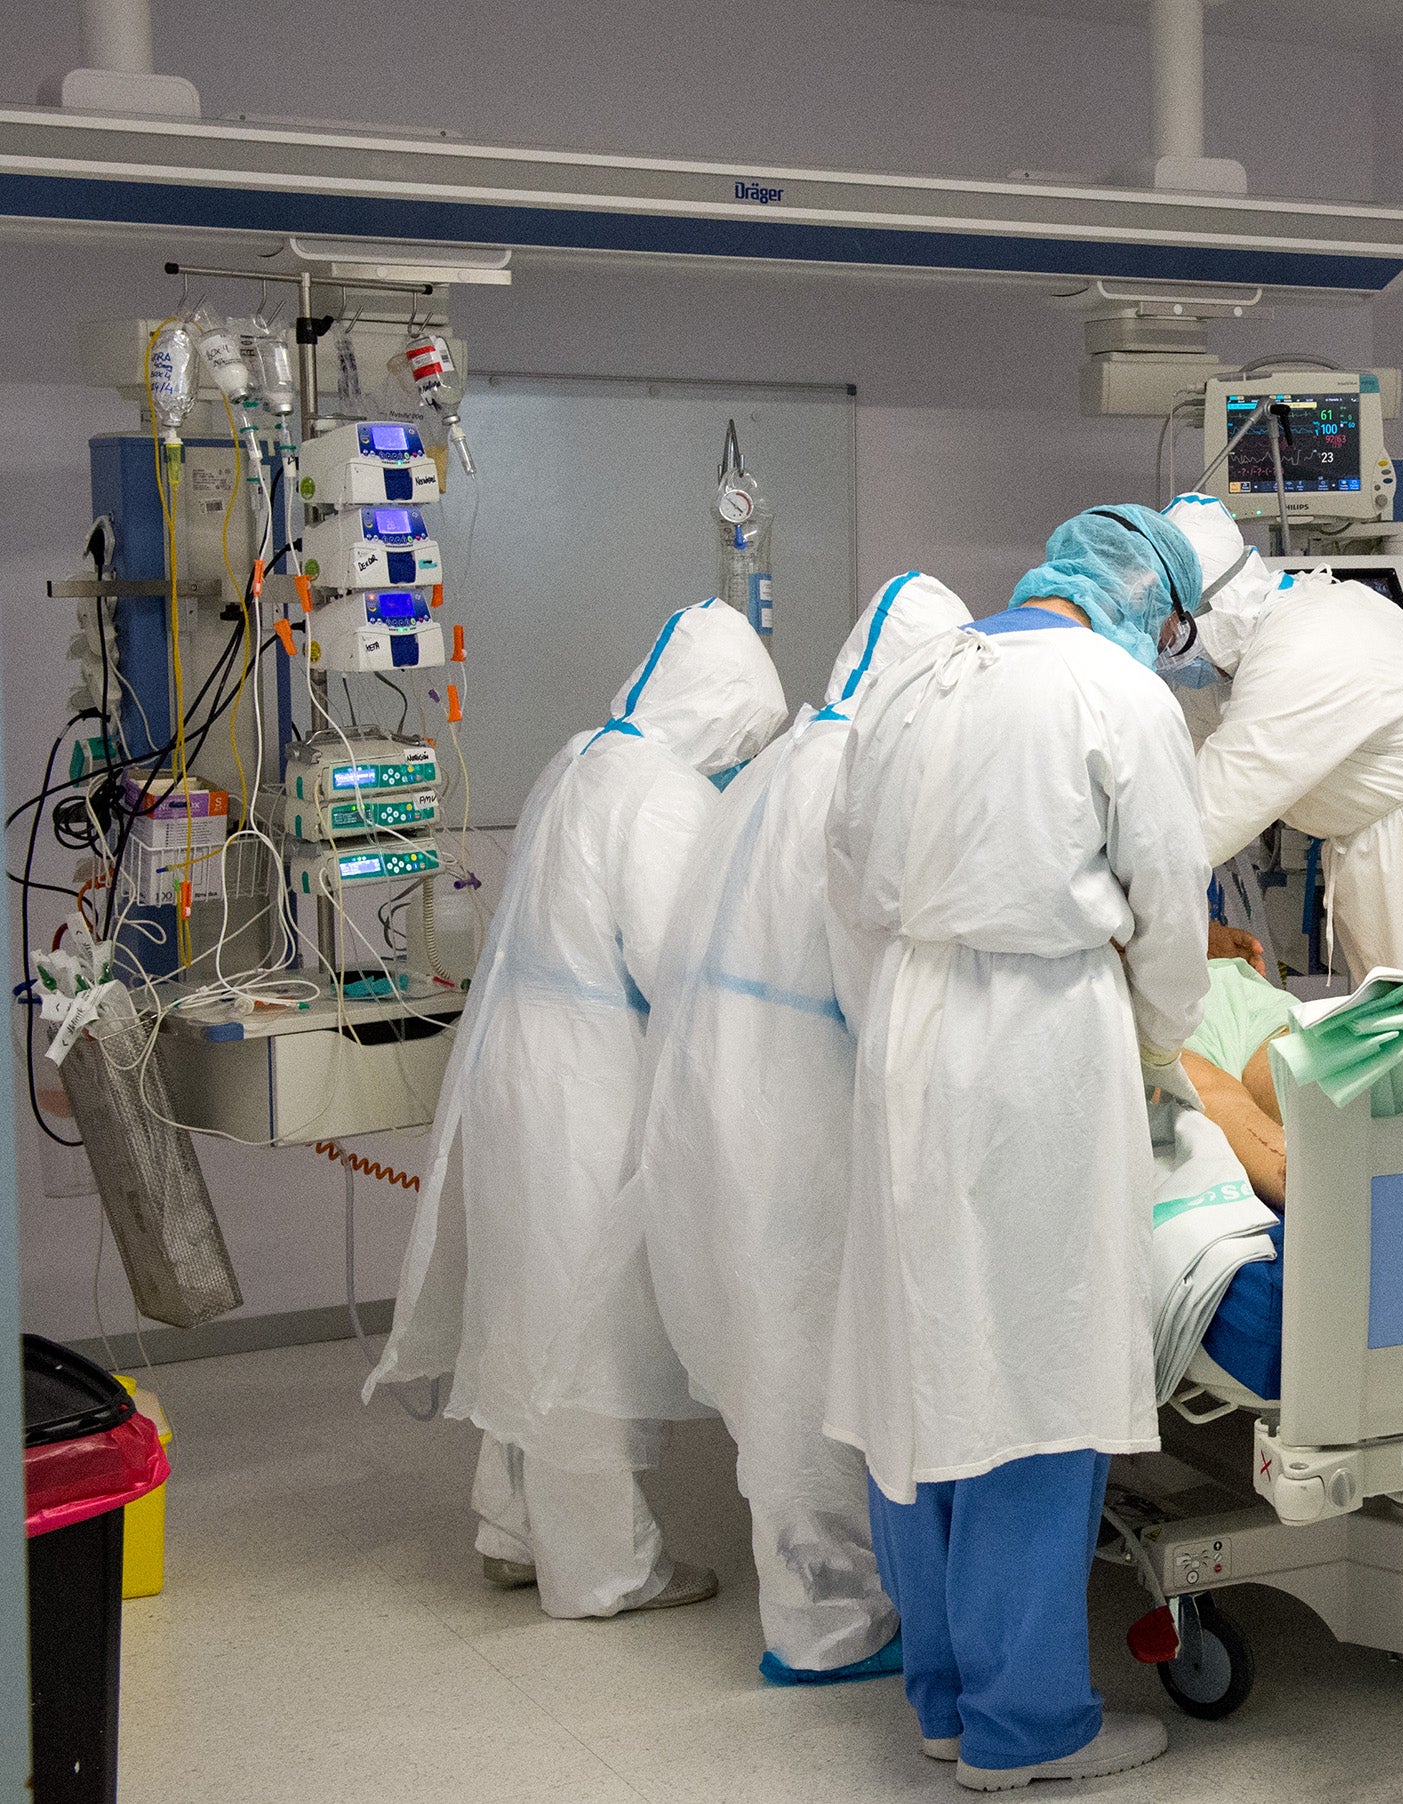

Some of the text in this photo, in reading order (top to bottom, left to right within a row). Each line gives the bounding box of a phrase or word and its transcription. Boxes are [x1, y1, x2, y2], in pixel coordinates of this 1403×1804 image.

[734, 181, 785, 204] Dräger
[1320, 409, 1333, 421] 61
[1320, 423, 1338, 435] 100
[1321, 452, 1334, 463] 23
[1285, 503, 1310, 511] HILIPS
[215, 797, 223, 807] S
